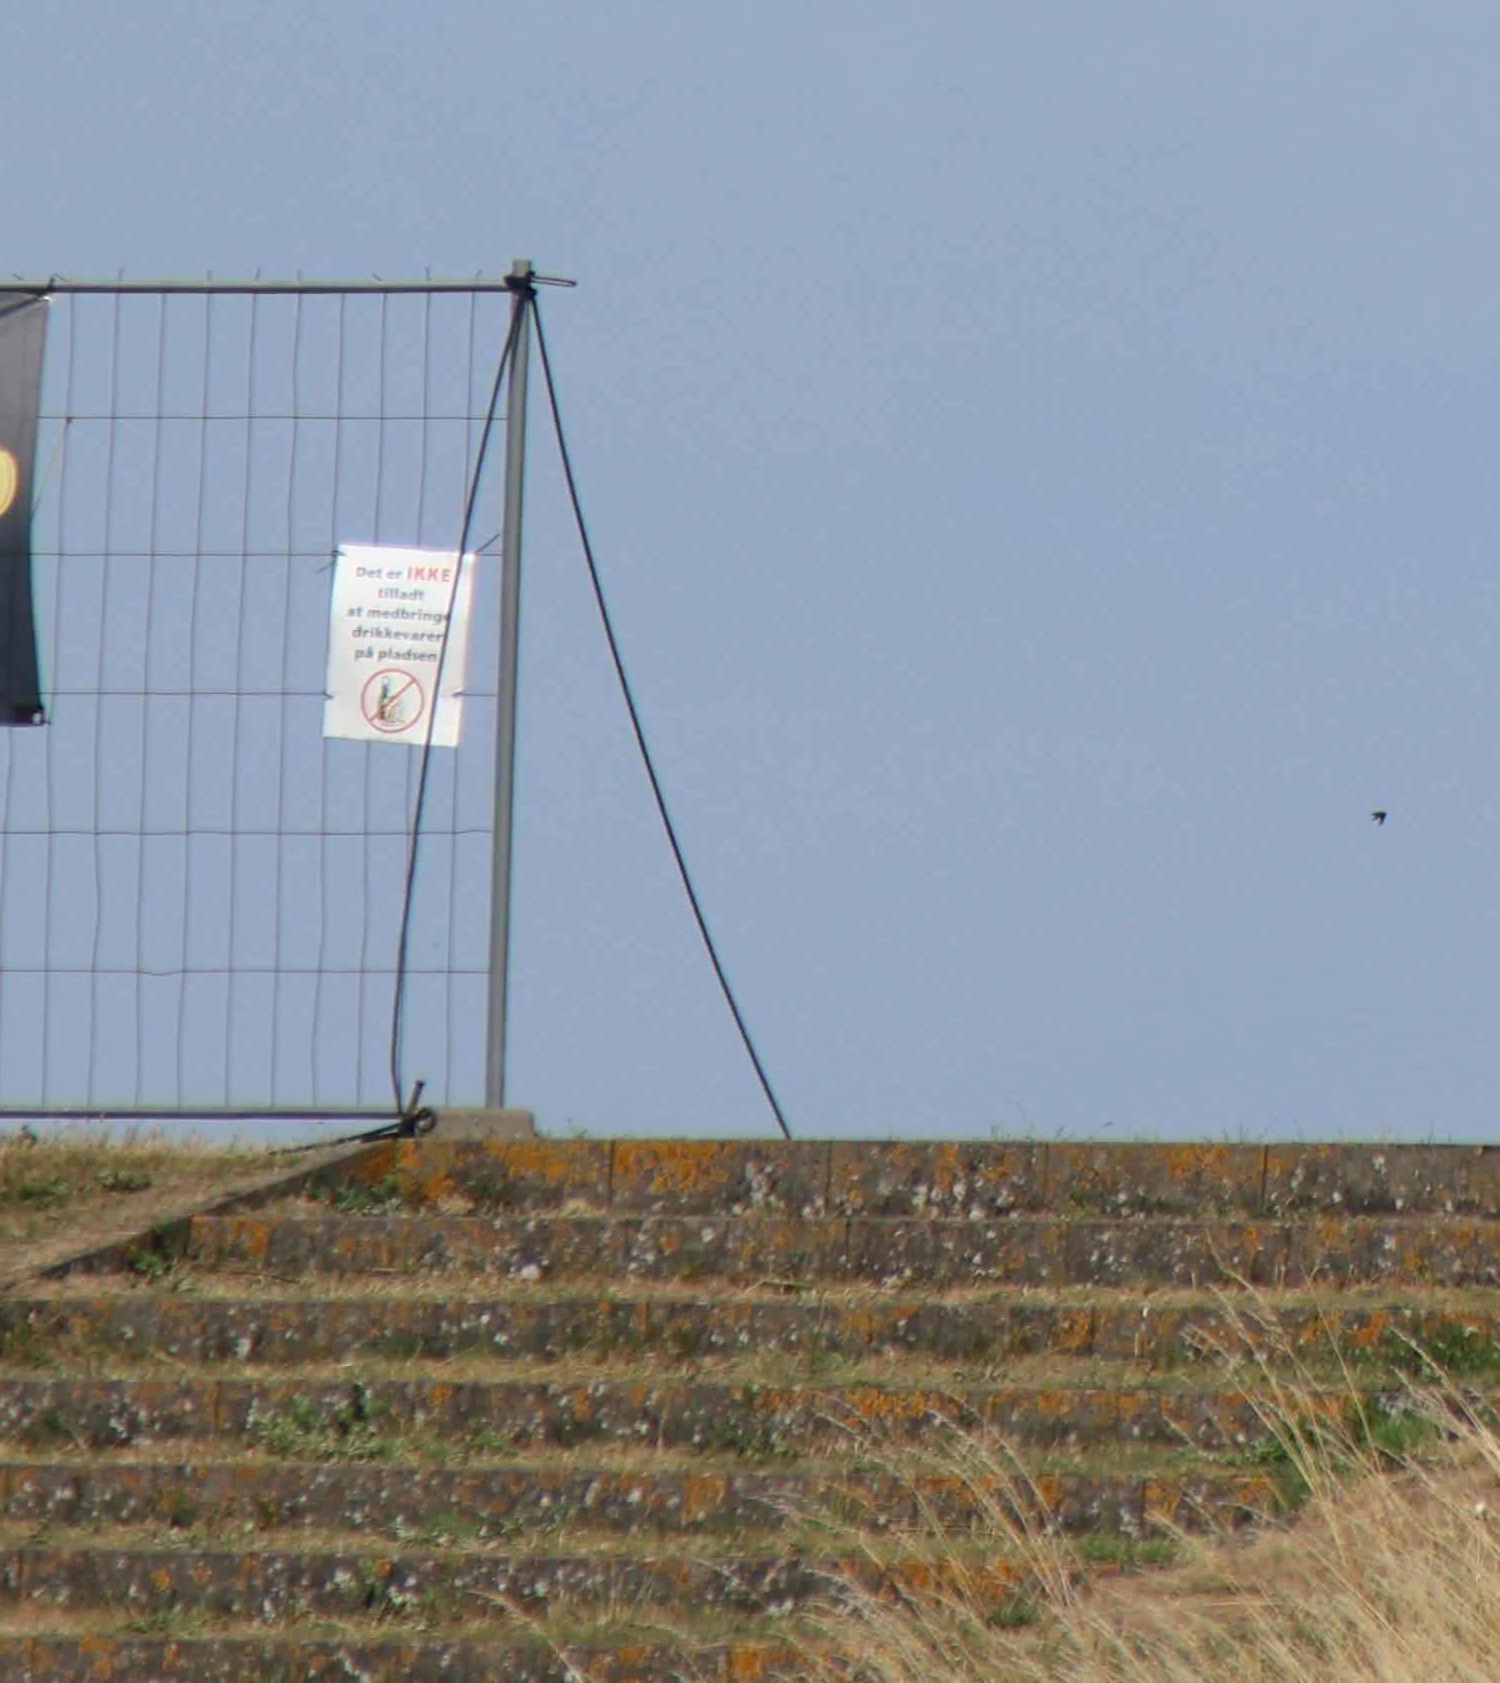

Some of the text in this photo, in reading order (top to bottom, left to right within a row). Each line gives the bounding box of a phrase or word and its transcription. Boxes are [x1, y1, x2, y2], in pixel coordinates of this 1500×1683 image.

[355, 566, 451, 582] Det er IKKE
[377, 587, 425, 601] tilladt
[346, 606, 363, 617] at
[351, 626, 444, 642] drikkevarer
[354, 645, 438, 663] på pladsen
